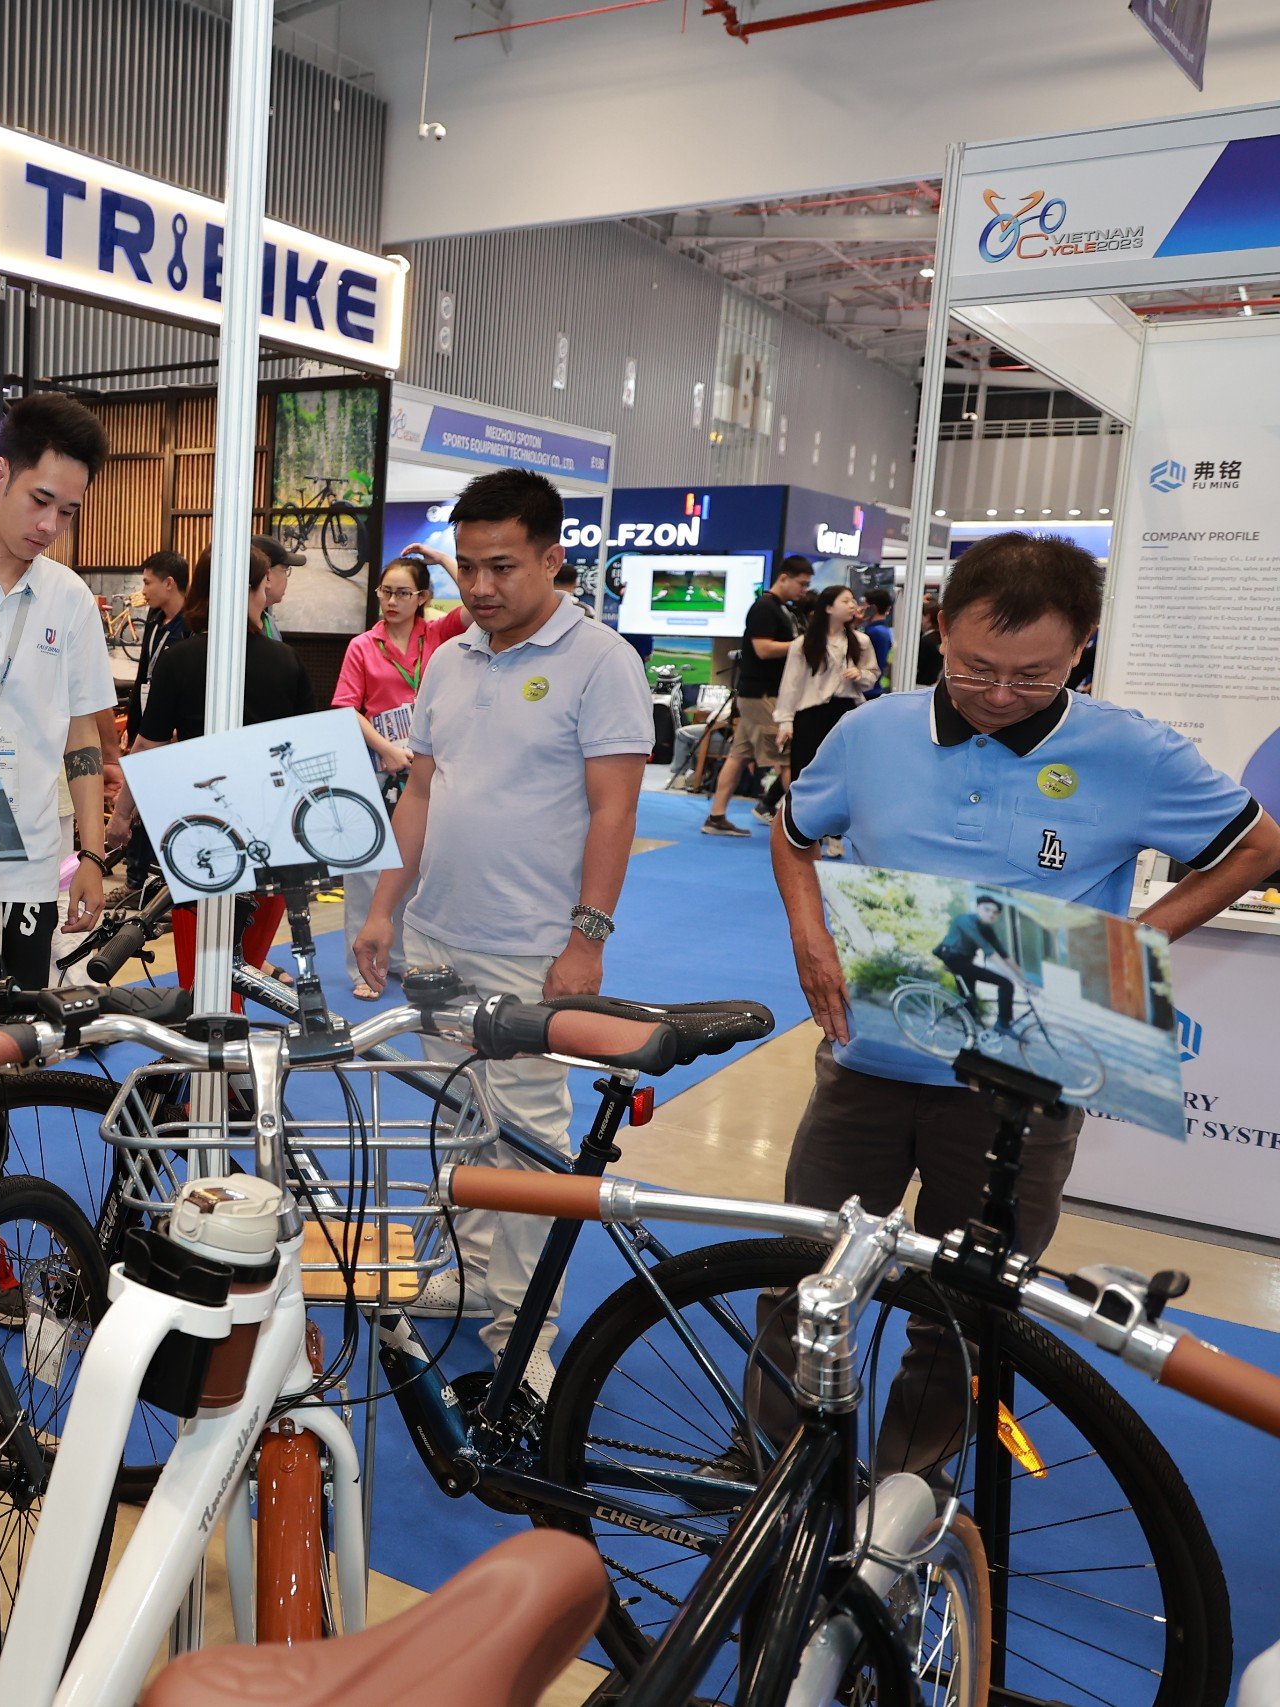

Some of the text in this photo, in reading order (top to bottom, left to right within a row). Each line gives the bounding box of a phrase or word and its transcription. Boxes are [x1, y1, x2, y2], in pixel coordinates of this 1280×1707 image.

[1051, 226, 1144, 245] VIETNAM
[442, 432, 470, 450] SPORTS
[470, 437, 510, 459] EQUIPMENT
[509, 444, 551, 466] TECHNOLOGY
[1210, 481, 1239, 489] MING
[1142, 531, 1260, 541] COMPANY PROFILE
[1038, 828, 1067, 870] LA
[260, 989, 299, 1014] PRO
[595, 1505, 705, 1550] CHEVAUX
